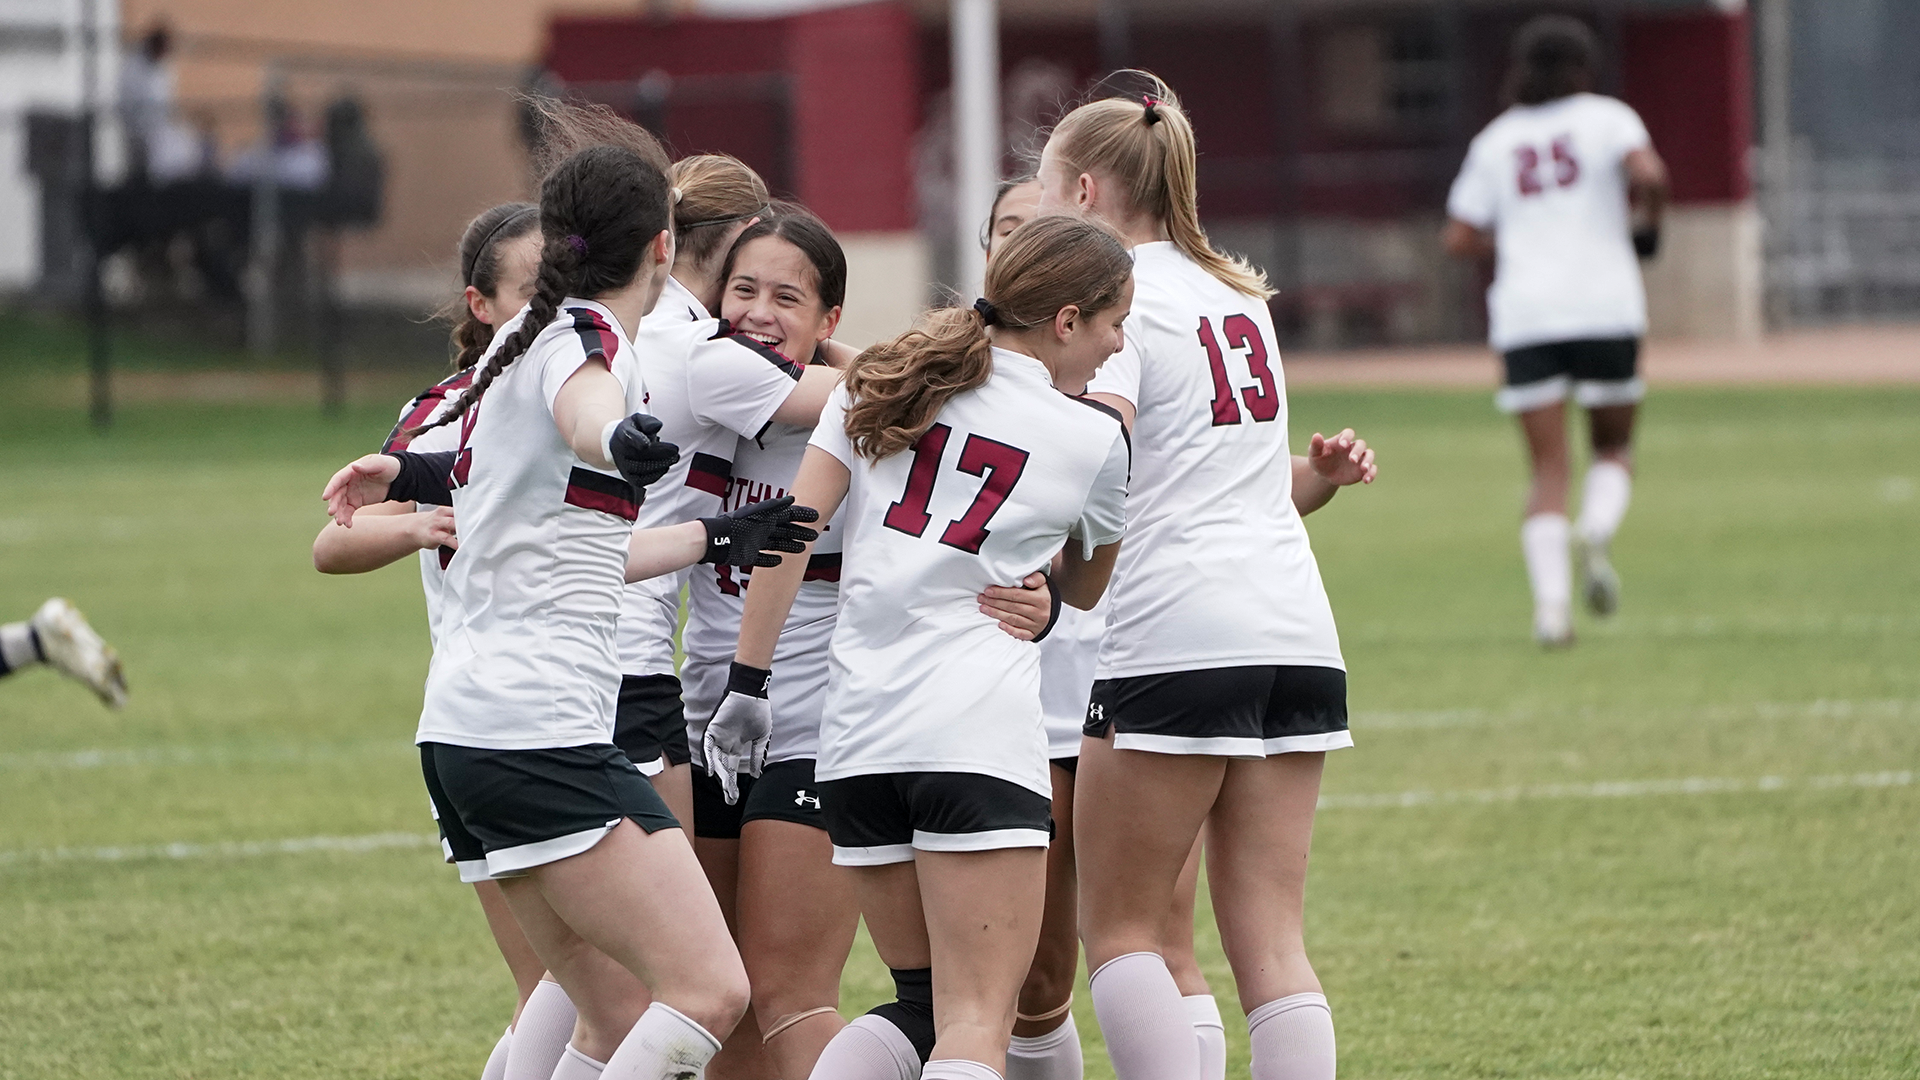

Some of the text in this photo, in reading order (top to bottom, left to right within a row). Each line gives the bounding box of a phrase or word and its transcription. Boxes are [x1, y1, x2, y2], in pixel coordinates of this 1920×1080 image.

[1516, 133, 1580, 197] 25
[1197, 313, 1280, 427] 13
[722, 476, 790, 513] RTHM
[883, 422, 1030, 555] 17
[714, 536, 731, 546] UA
